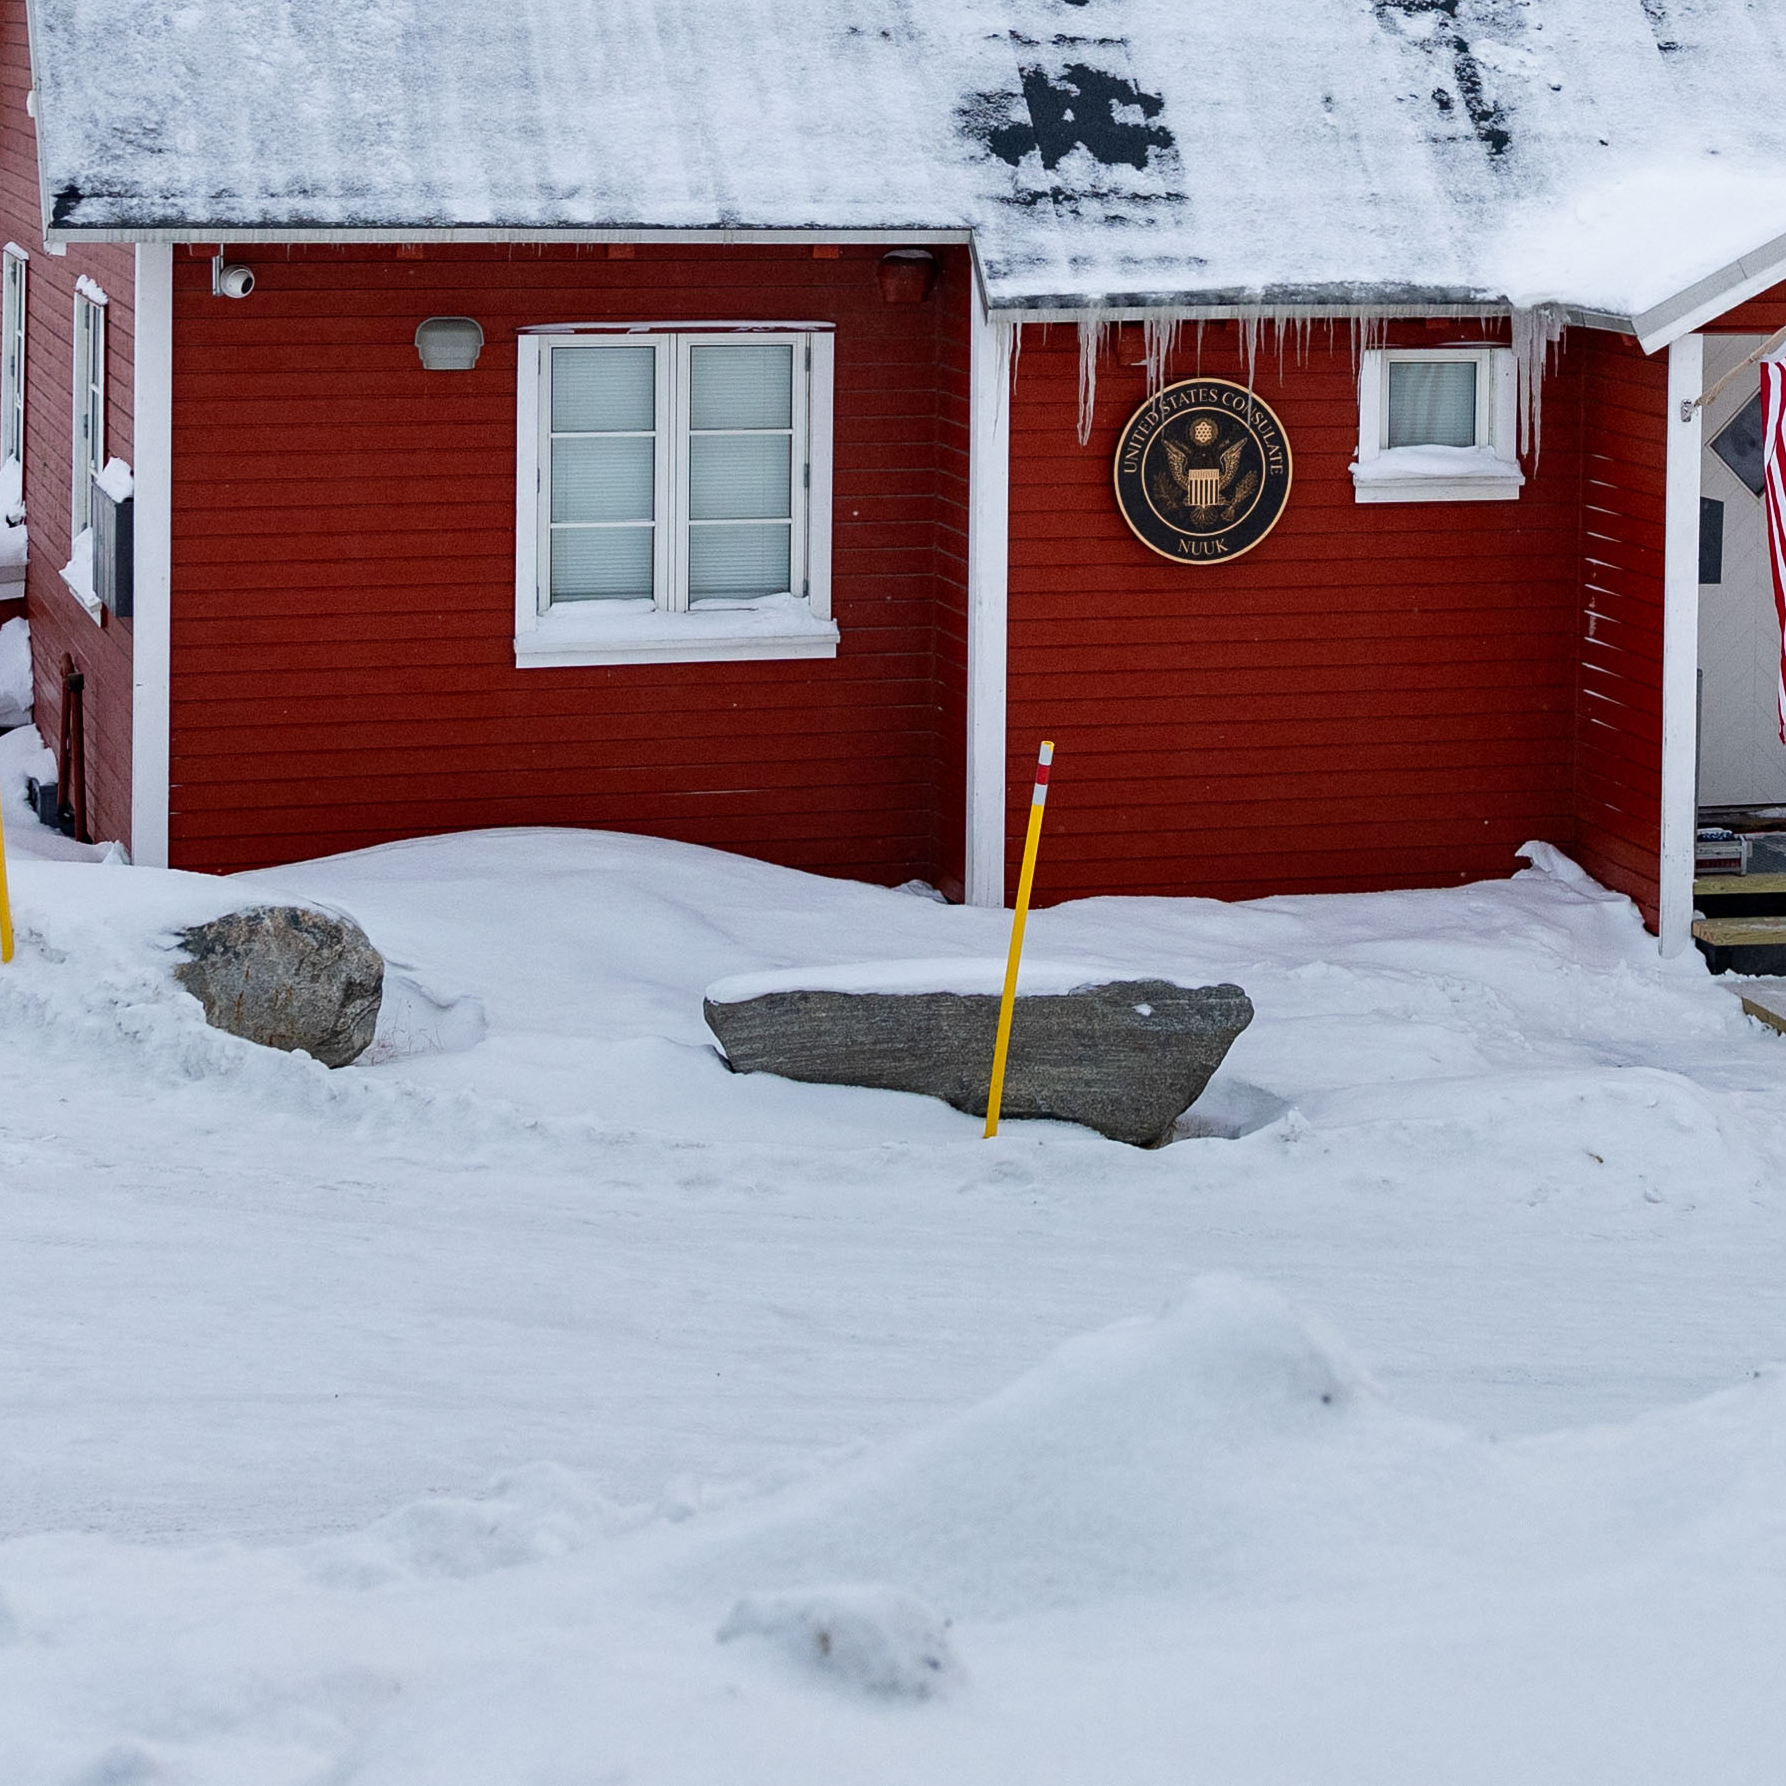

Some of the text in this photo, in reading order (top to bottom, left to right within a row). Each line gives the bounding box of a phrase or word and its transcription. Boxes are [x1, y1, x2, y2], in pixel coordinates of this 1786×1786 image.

[1123, 388, 1284, 476] UNITED STATES CONSULATE
[1177, 538, 1229, 556] NUUK
